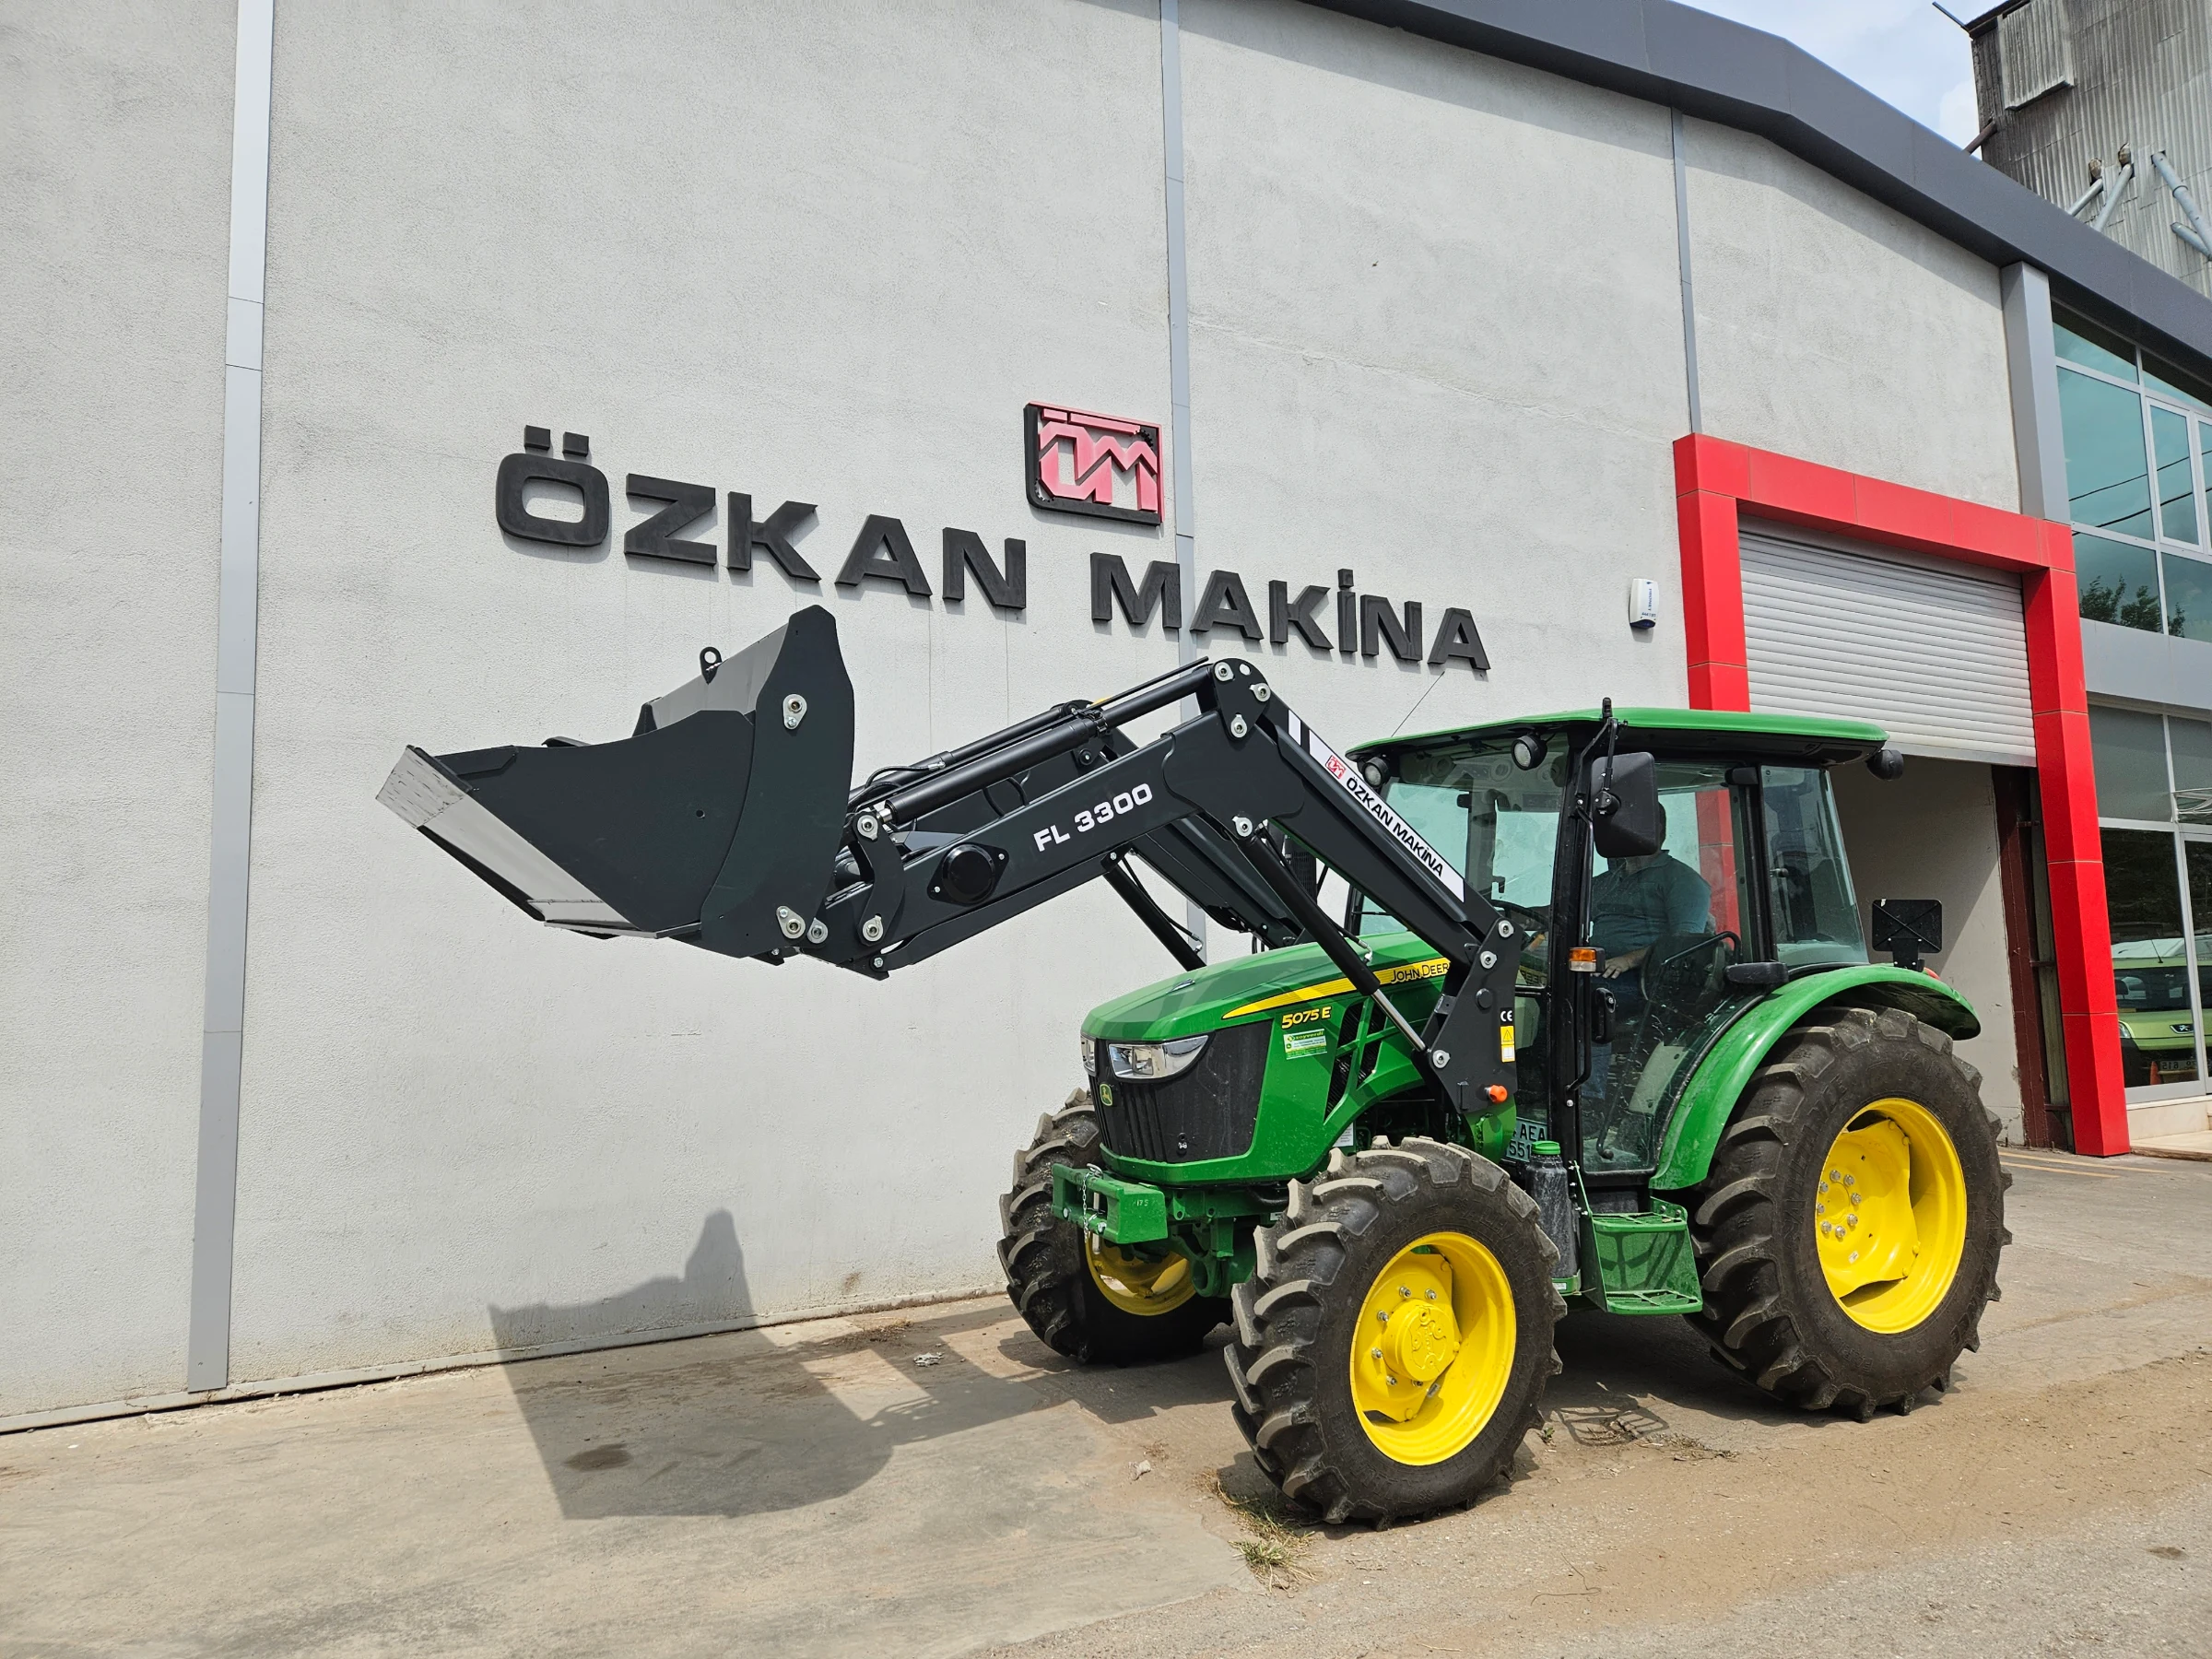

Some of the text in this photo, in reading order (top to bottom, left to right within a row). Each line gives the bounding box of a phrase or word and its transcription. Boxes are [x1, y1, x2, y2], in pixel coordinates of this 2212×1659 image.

[496, 425, 1491, 671] ÖZKAN MAKİNA
[1033, 783, 1153, 852] FL 3300
[1346, 776, 1444, 877] ÖZKAN MAKİNA
[1390, 962, 1450, 982] JOHN DEER
[1281, 1006, 1332, 1029] 5075 E
[1500, 1010, 1513, 1022] CE
[1520, 1123, 1546, 1142] AEA
